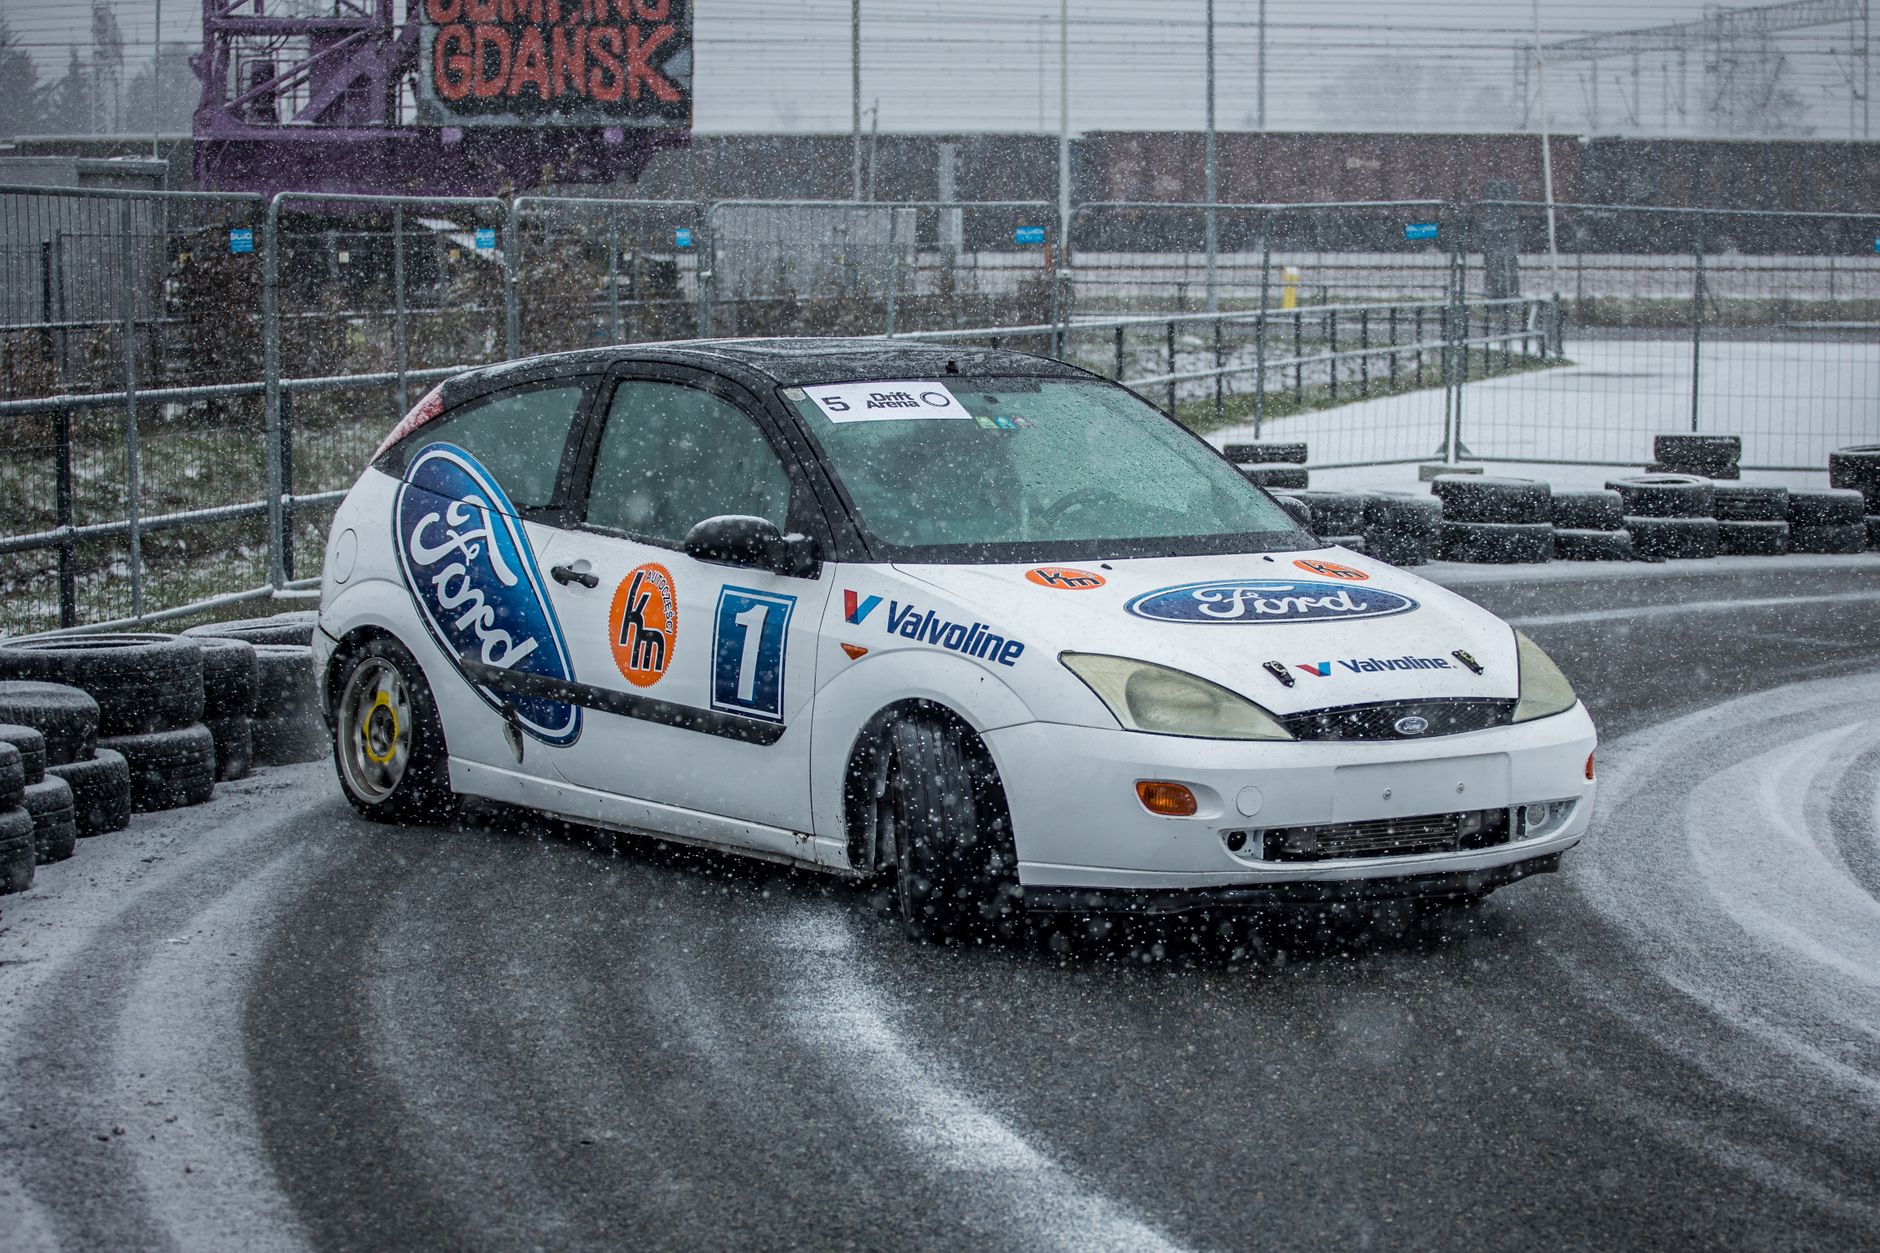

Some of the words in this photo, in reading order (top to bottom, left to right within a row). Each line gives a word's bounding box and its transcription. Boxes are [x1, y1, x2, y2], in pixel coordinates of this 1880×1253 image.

[820, 396, 851, 412] 5
[866, 400, 920, 409] Arena
[869, 392, 914, 402] Drift
[1033, 569, 1102, 589] km
[1301, 560, 1365, 578] km
[410, 494, 539, 668] Ford
[1191, 585, 1368, 618] Ford
[618, 569, 667, 673] km
[886, 600, 1026, 667] Valvoline
[734, 604, 769, 702] 1
[1337, 655, 1452, 673] Valvoline
